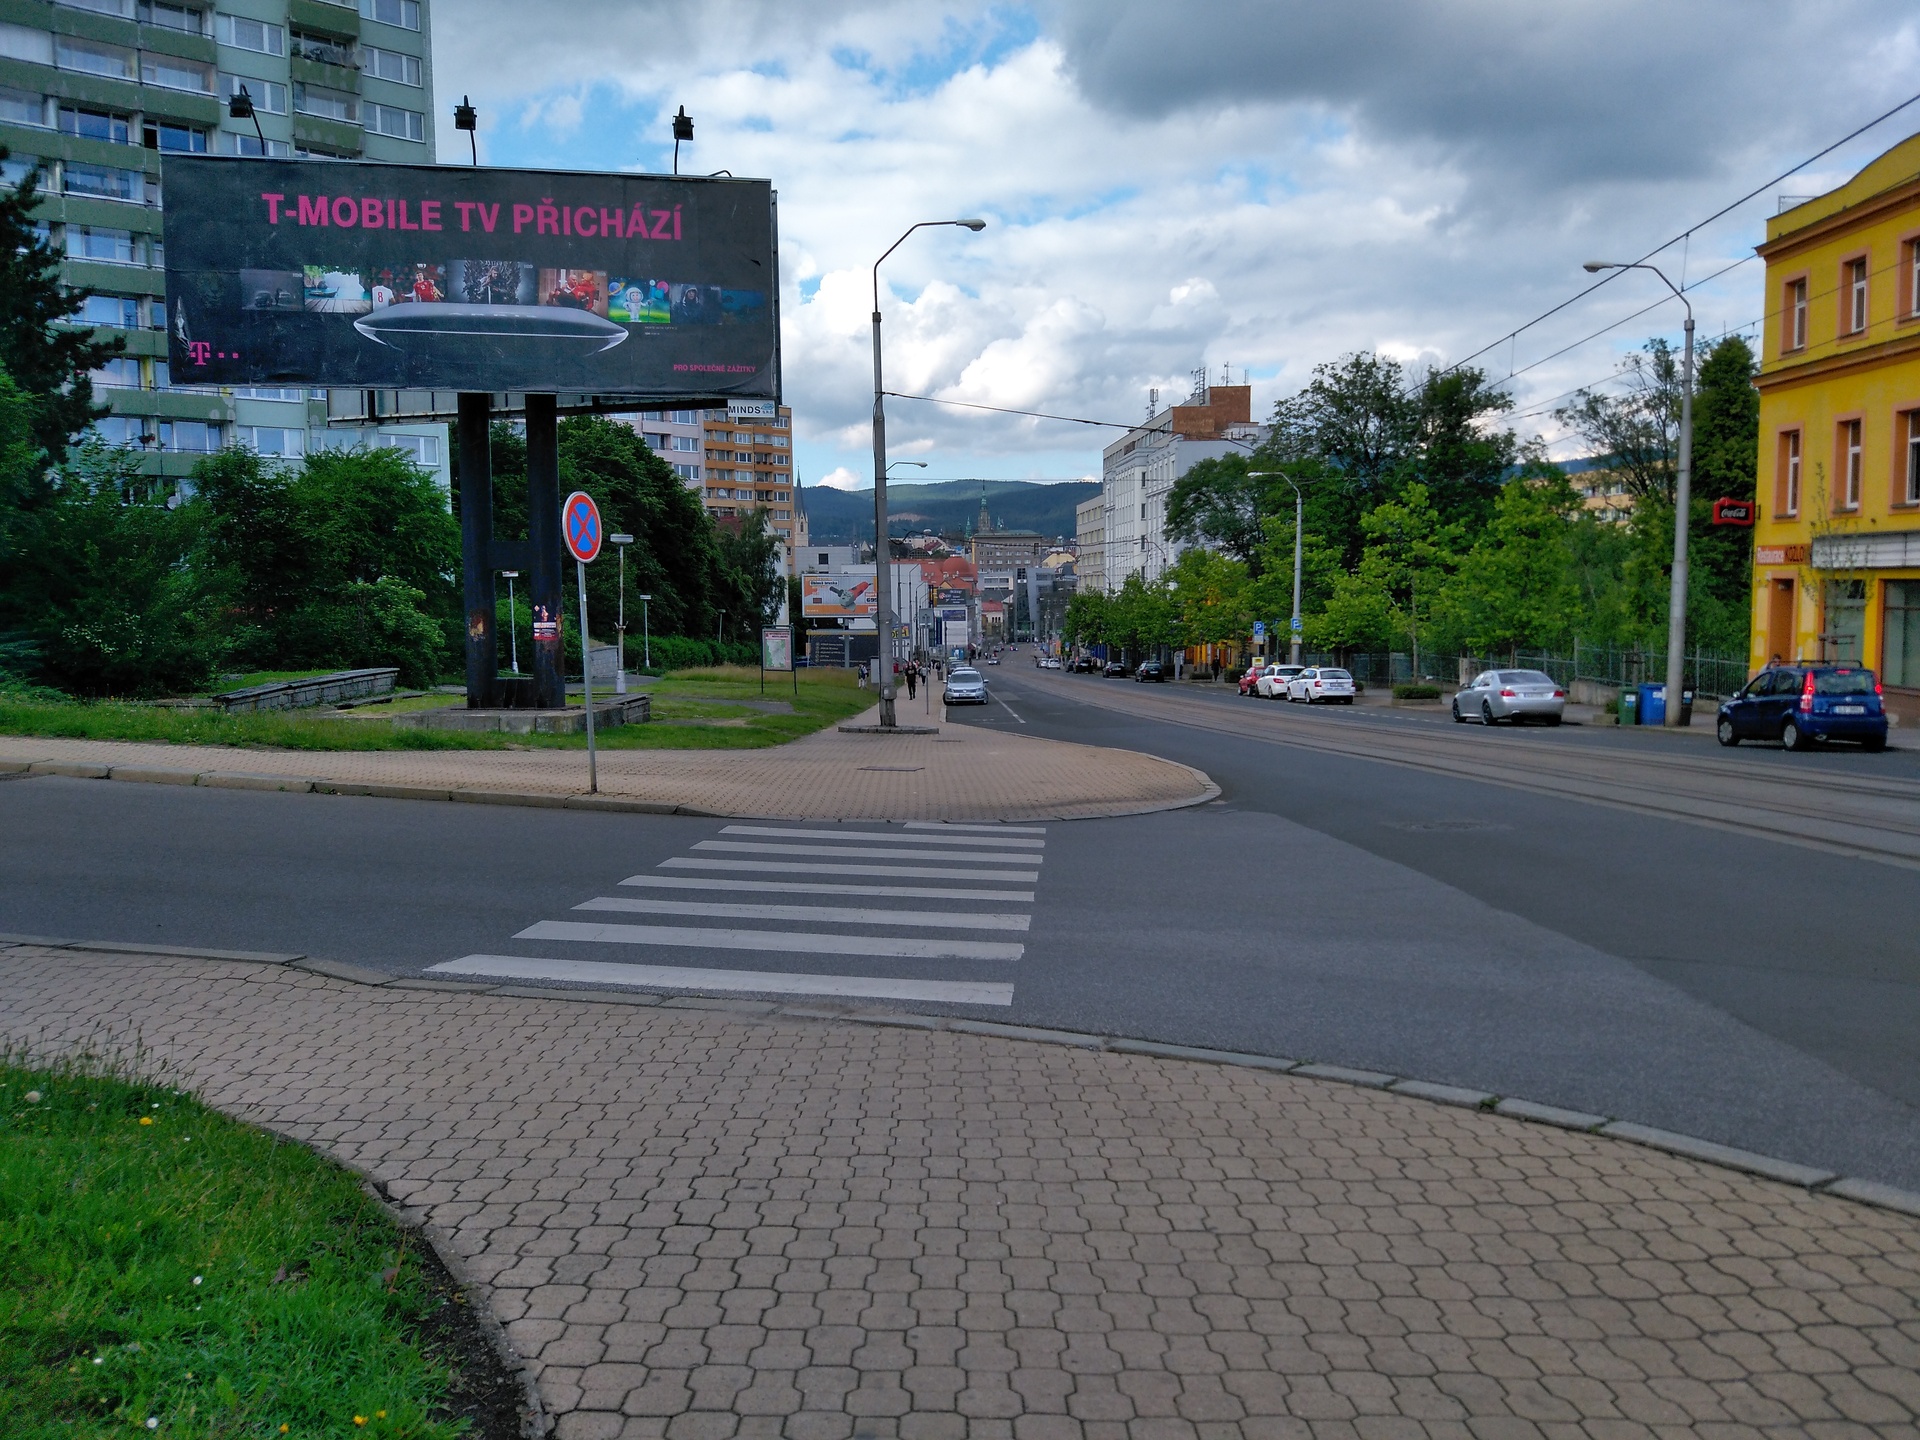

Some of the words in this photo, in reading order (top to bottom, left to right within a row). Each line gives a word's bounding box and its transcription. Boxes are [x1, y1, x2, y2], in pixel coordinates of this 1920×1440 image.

[261, 193, 443, 231] T-MOBILE
[454, 202, 500, 233] TV
[513, 197, 683, 241] PŘICHÁZÍ
[377, 291, 384, 302] 8
[690, 363, 726, 372] SPOLEČNÉ
[727, 364, 756, 373] ZÁŽITKY
[728, 405, 761, 414] MINDS
